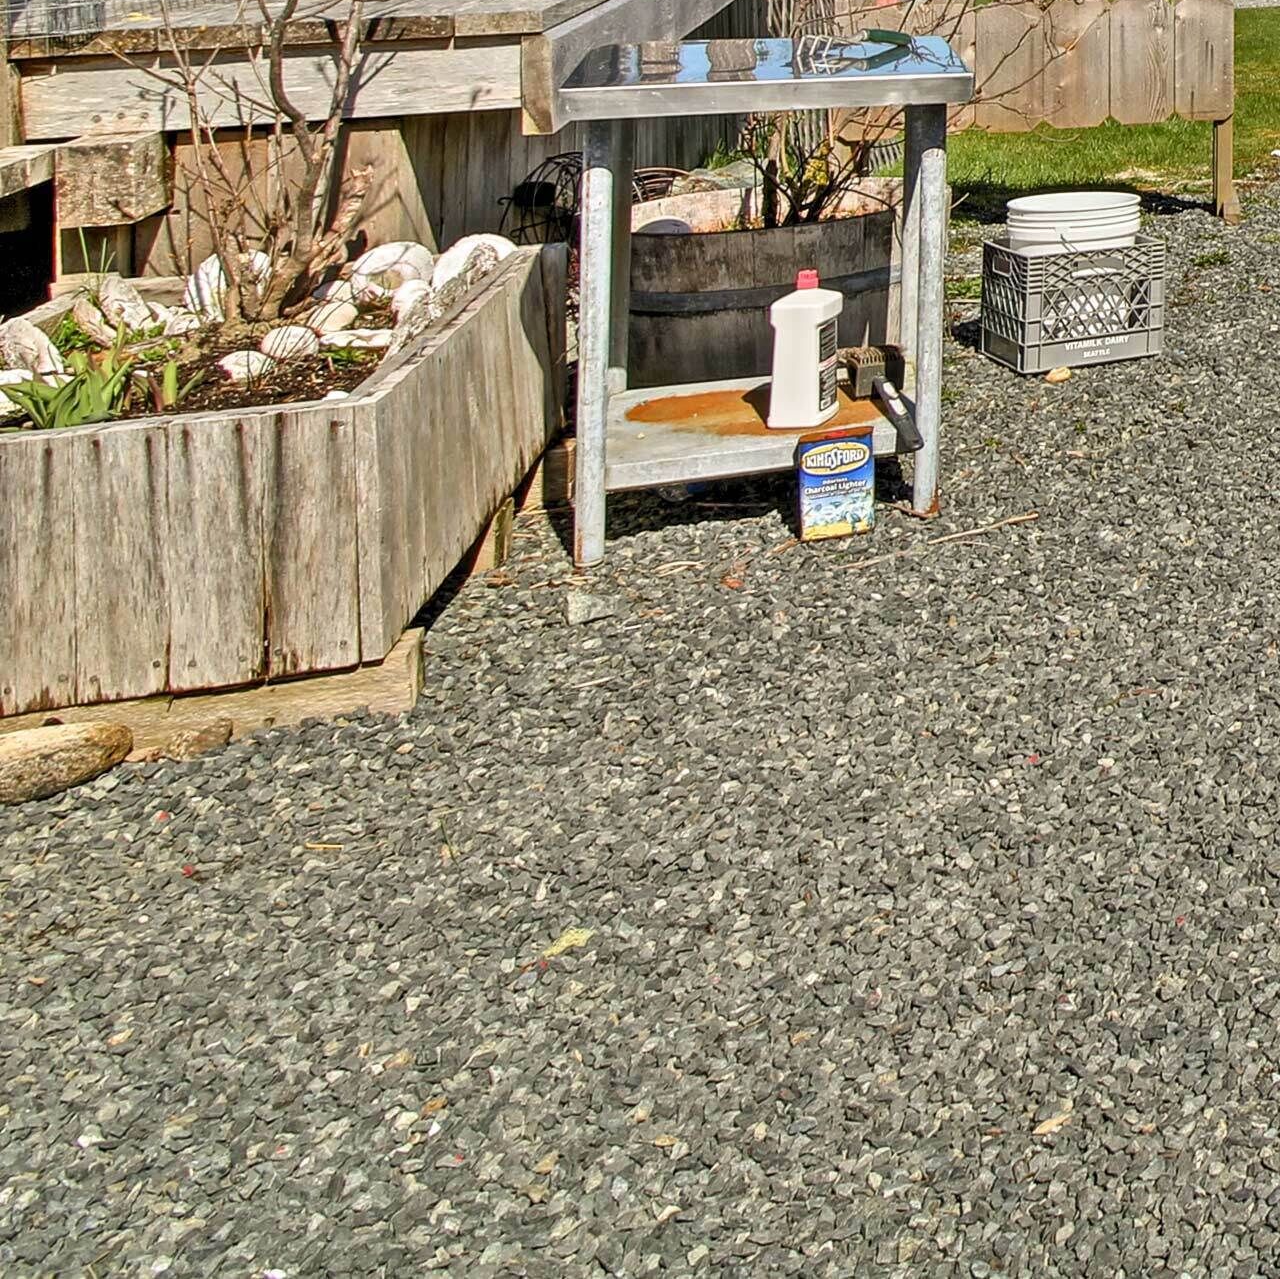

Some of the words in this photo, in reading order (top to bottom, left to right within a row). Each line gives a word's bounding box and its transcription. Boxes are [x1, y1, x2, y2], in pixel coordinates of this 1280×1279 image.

[1065, 339, 1102, 350] VITAMILK
[1105, 335, 1129, 345] DAIRY
[1084, 349, 1110, 358] SEATTLE
[805, 446, 865, 470] KINGSFORD
[805, 484, 837, 495] Charcoal
[839, 480, 866, 490] Lighter
